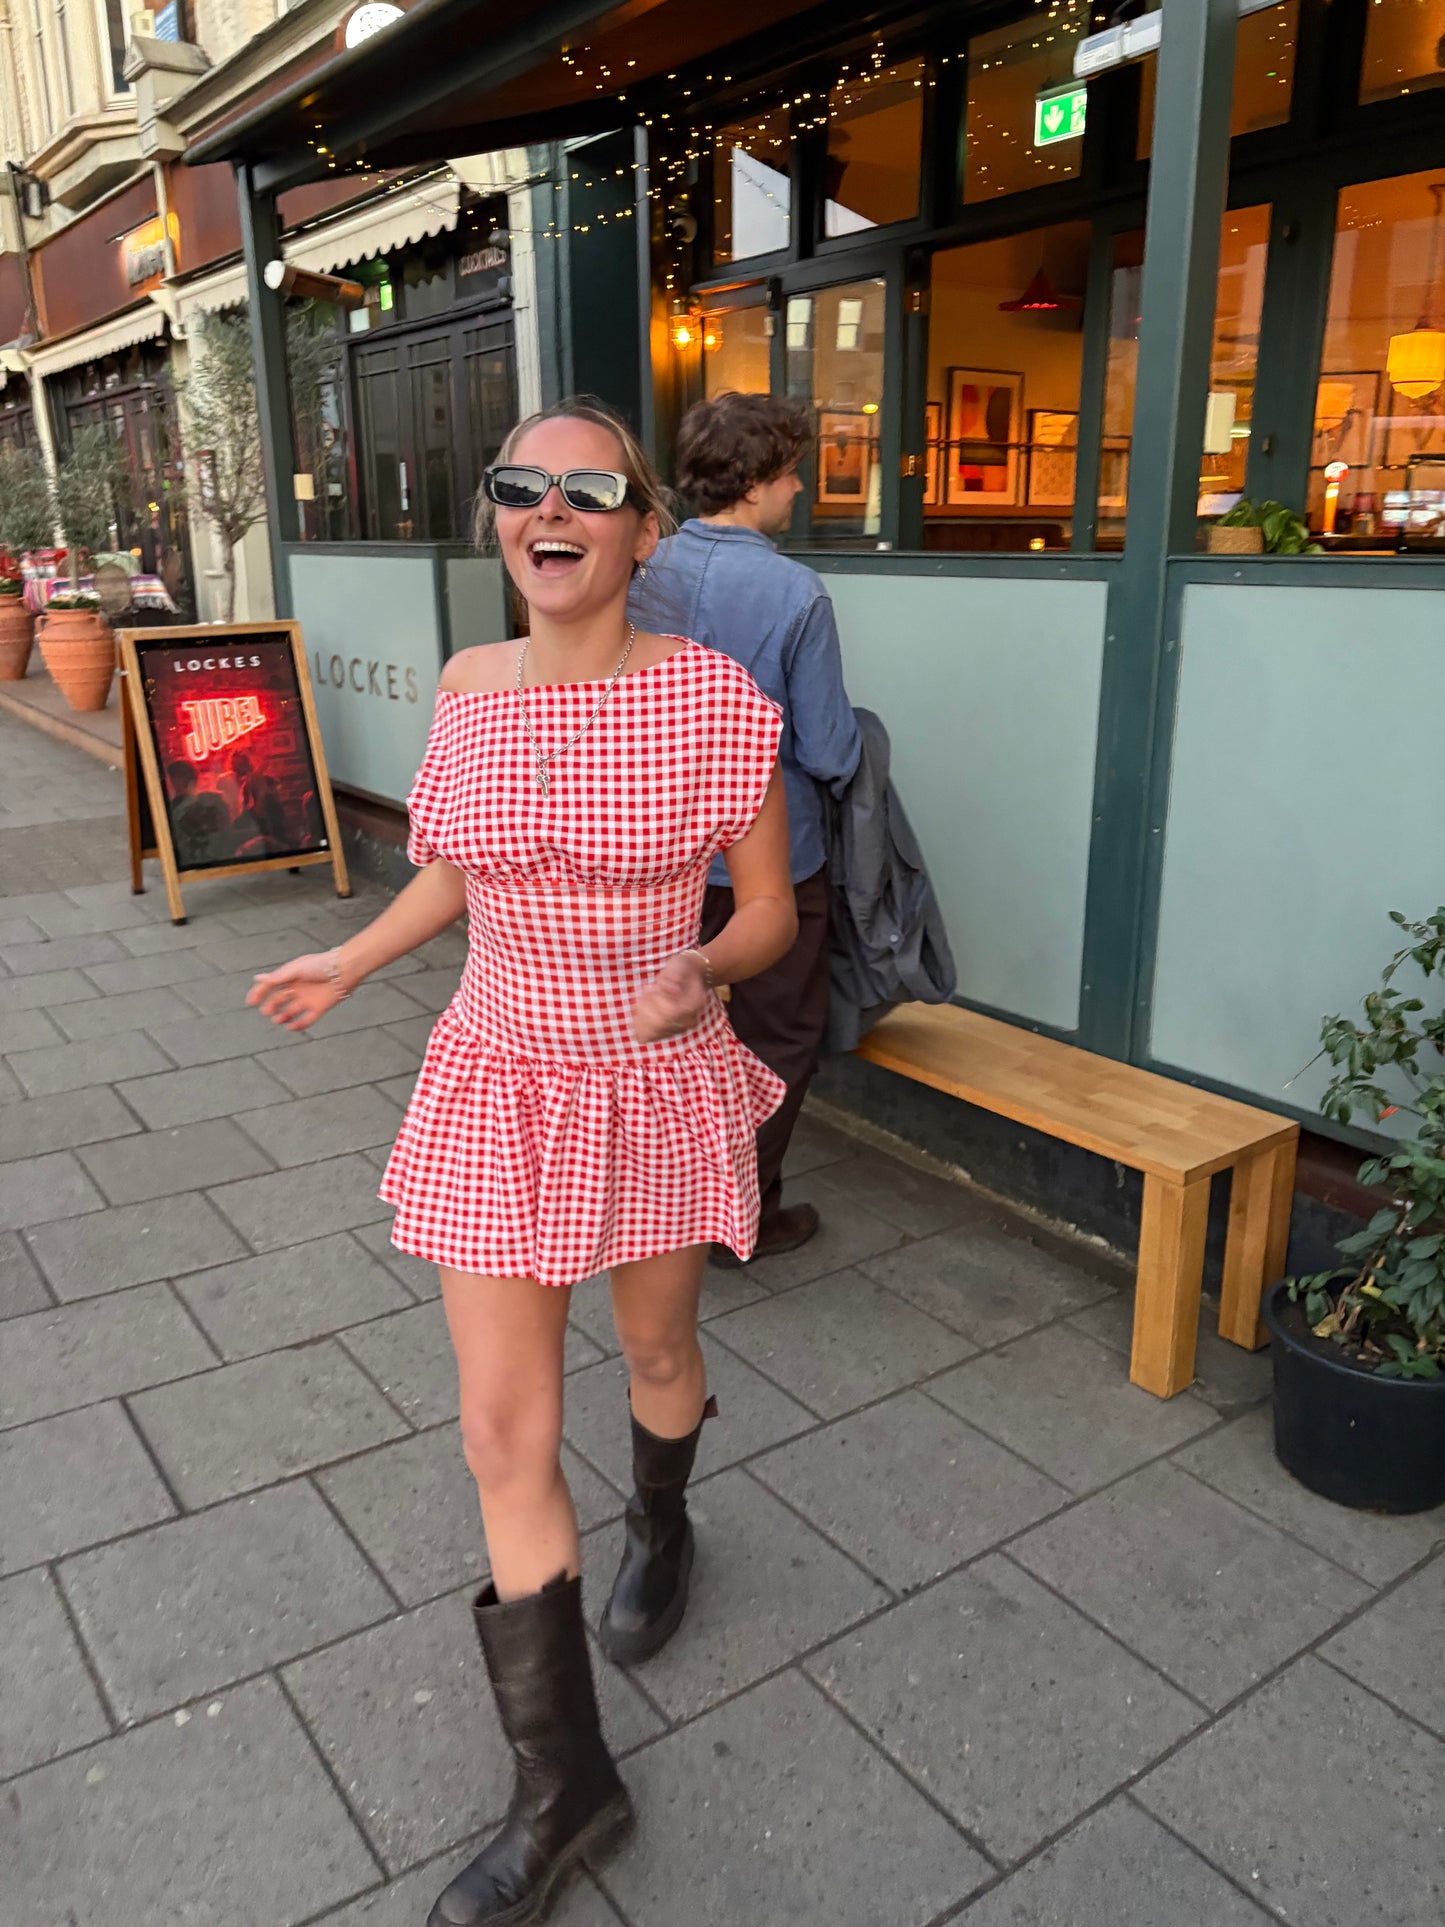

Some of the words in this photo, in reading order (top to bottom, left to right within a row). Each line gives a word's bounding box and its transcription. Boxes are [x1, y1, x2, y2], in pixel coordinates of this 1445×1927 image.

[173, 655, 261, 672] LOCKES
[315, 651, 418, 704] LOCKES
[181, 696, 266, 760] JUBEL
